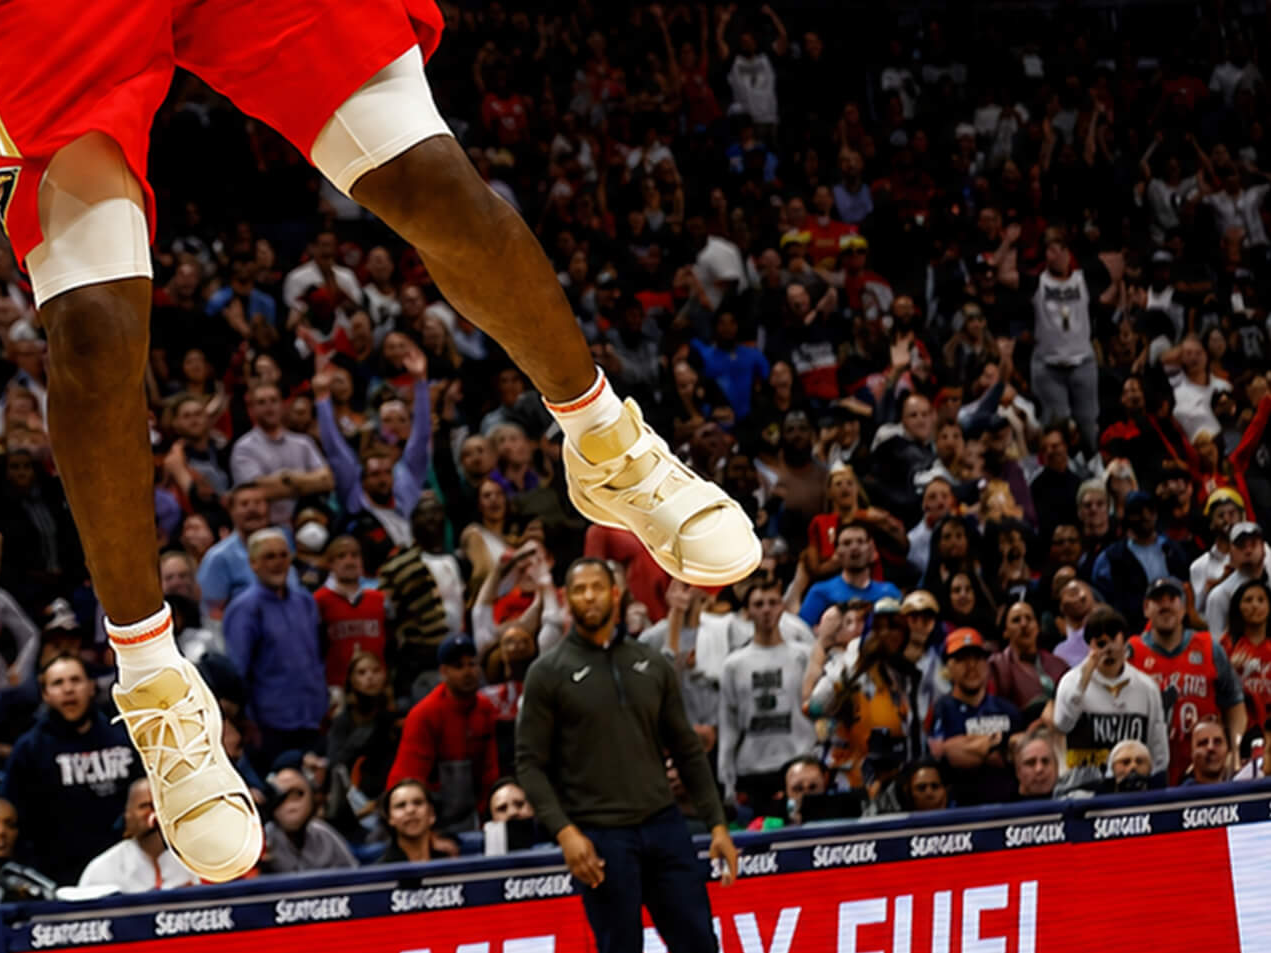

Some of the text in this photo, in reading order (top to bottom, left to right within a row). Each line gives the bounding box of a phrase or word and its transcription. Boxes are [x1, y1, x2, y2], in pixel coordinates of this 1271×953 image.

[1094, 814, 1151, 839] SEATGEEK
[1183, 804, 1239, 829] SEATGEEK
[909, 832, 972, 858] SEATGEEK
[1005, 821, 1065, 847] SEATGEEK
[813, 841, 877, 868] SEATGEEK
[391, 884, 465, 912] SEATGEEK
[504, 874, 574, 900] SEATGEEK
[155, 908, 234, 936] SEATGEEK
[275, 896, 351, 924] SEATGEEK
[31, 919, 112, 949] SEATGEEK
